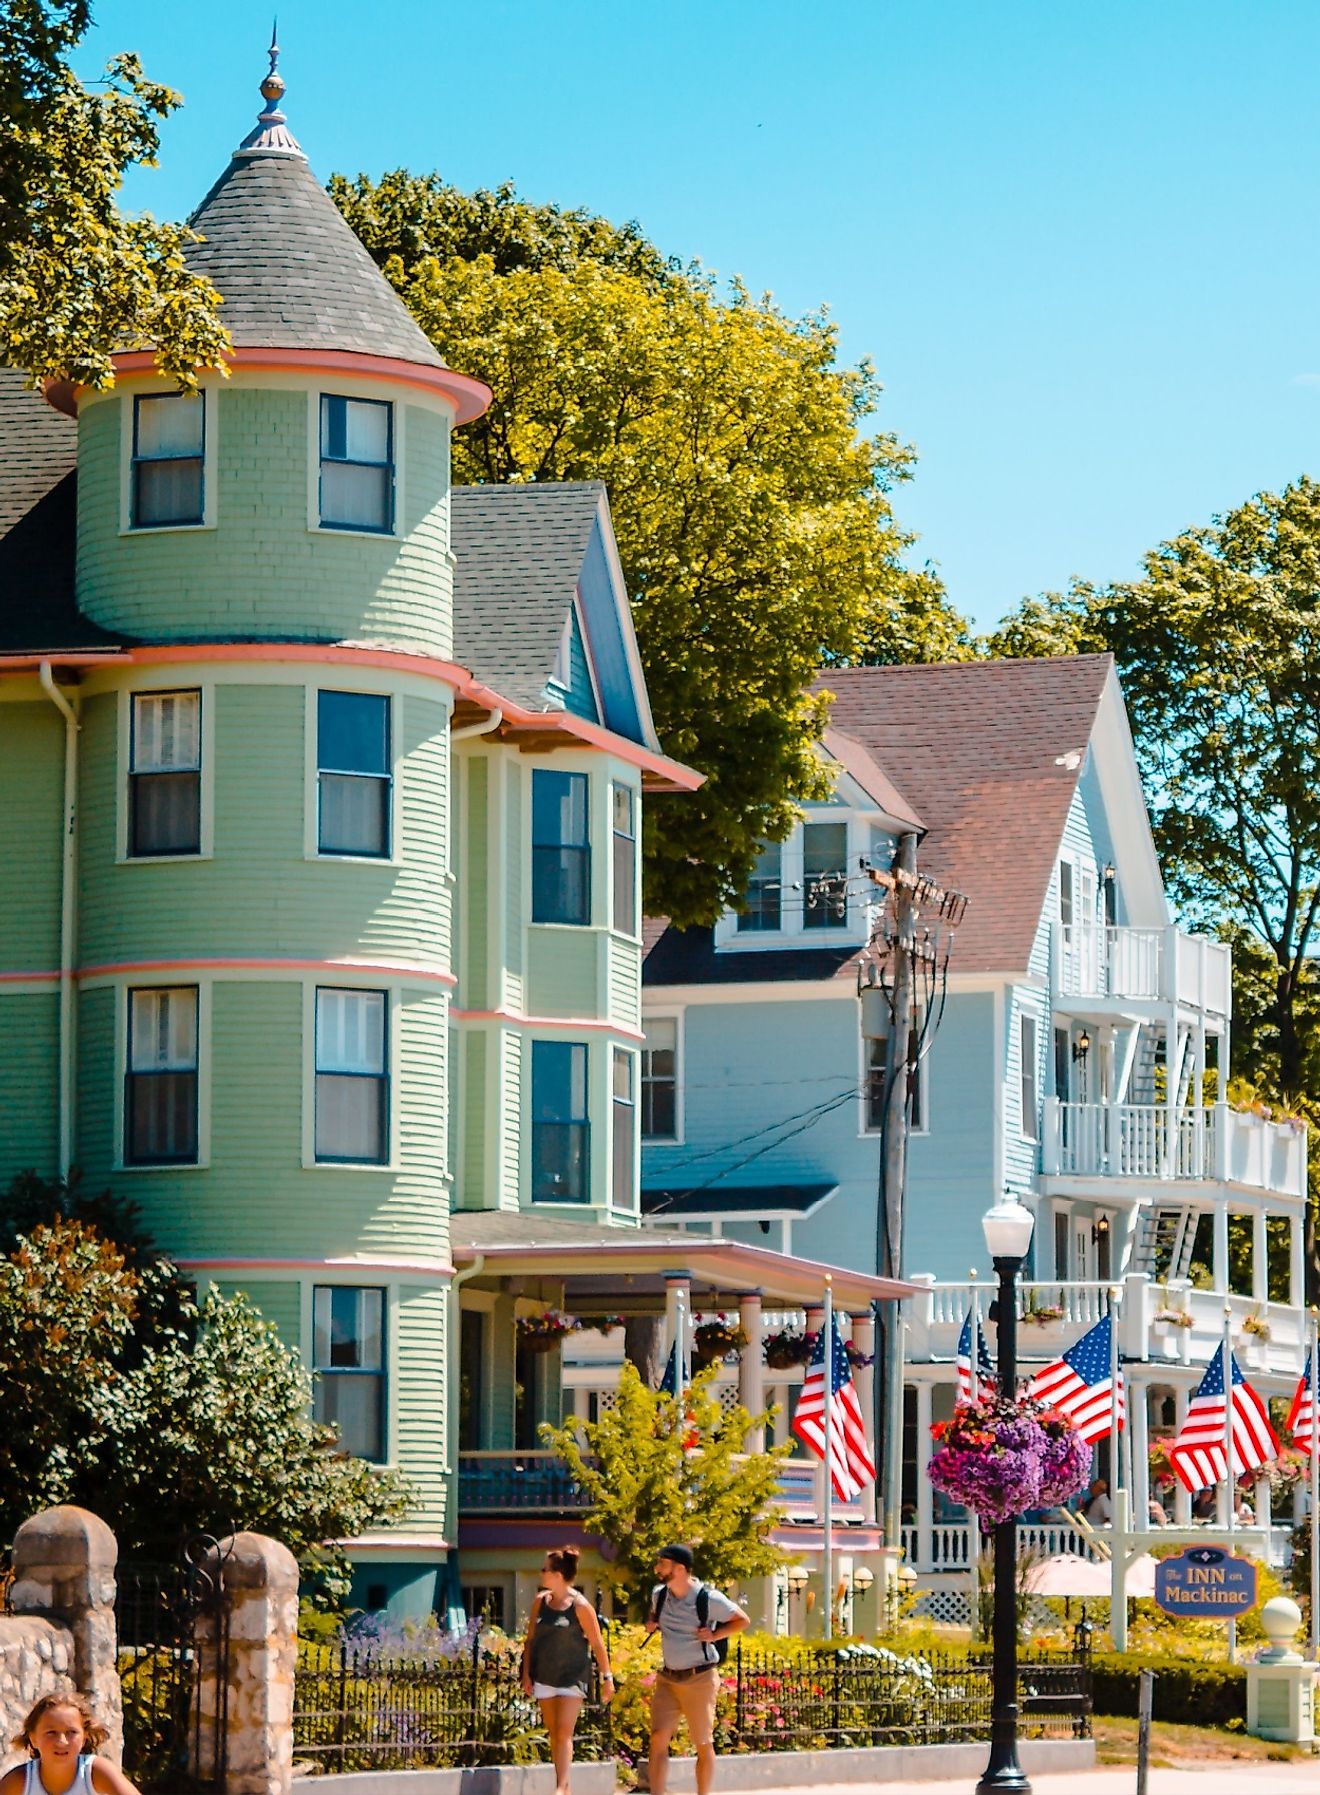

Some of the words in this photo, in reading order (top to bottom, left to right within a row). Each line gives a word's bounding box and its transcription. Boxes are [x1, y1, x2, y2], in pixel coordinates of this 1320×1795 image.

[1166, 1569, 1182, 1581] The
[1187, 1568, 1225, 1584] INN
[1229, 1573, 1242, 1581] on
[1165, 1586, 1248, 1603] Mackinac
